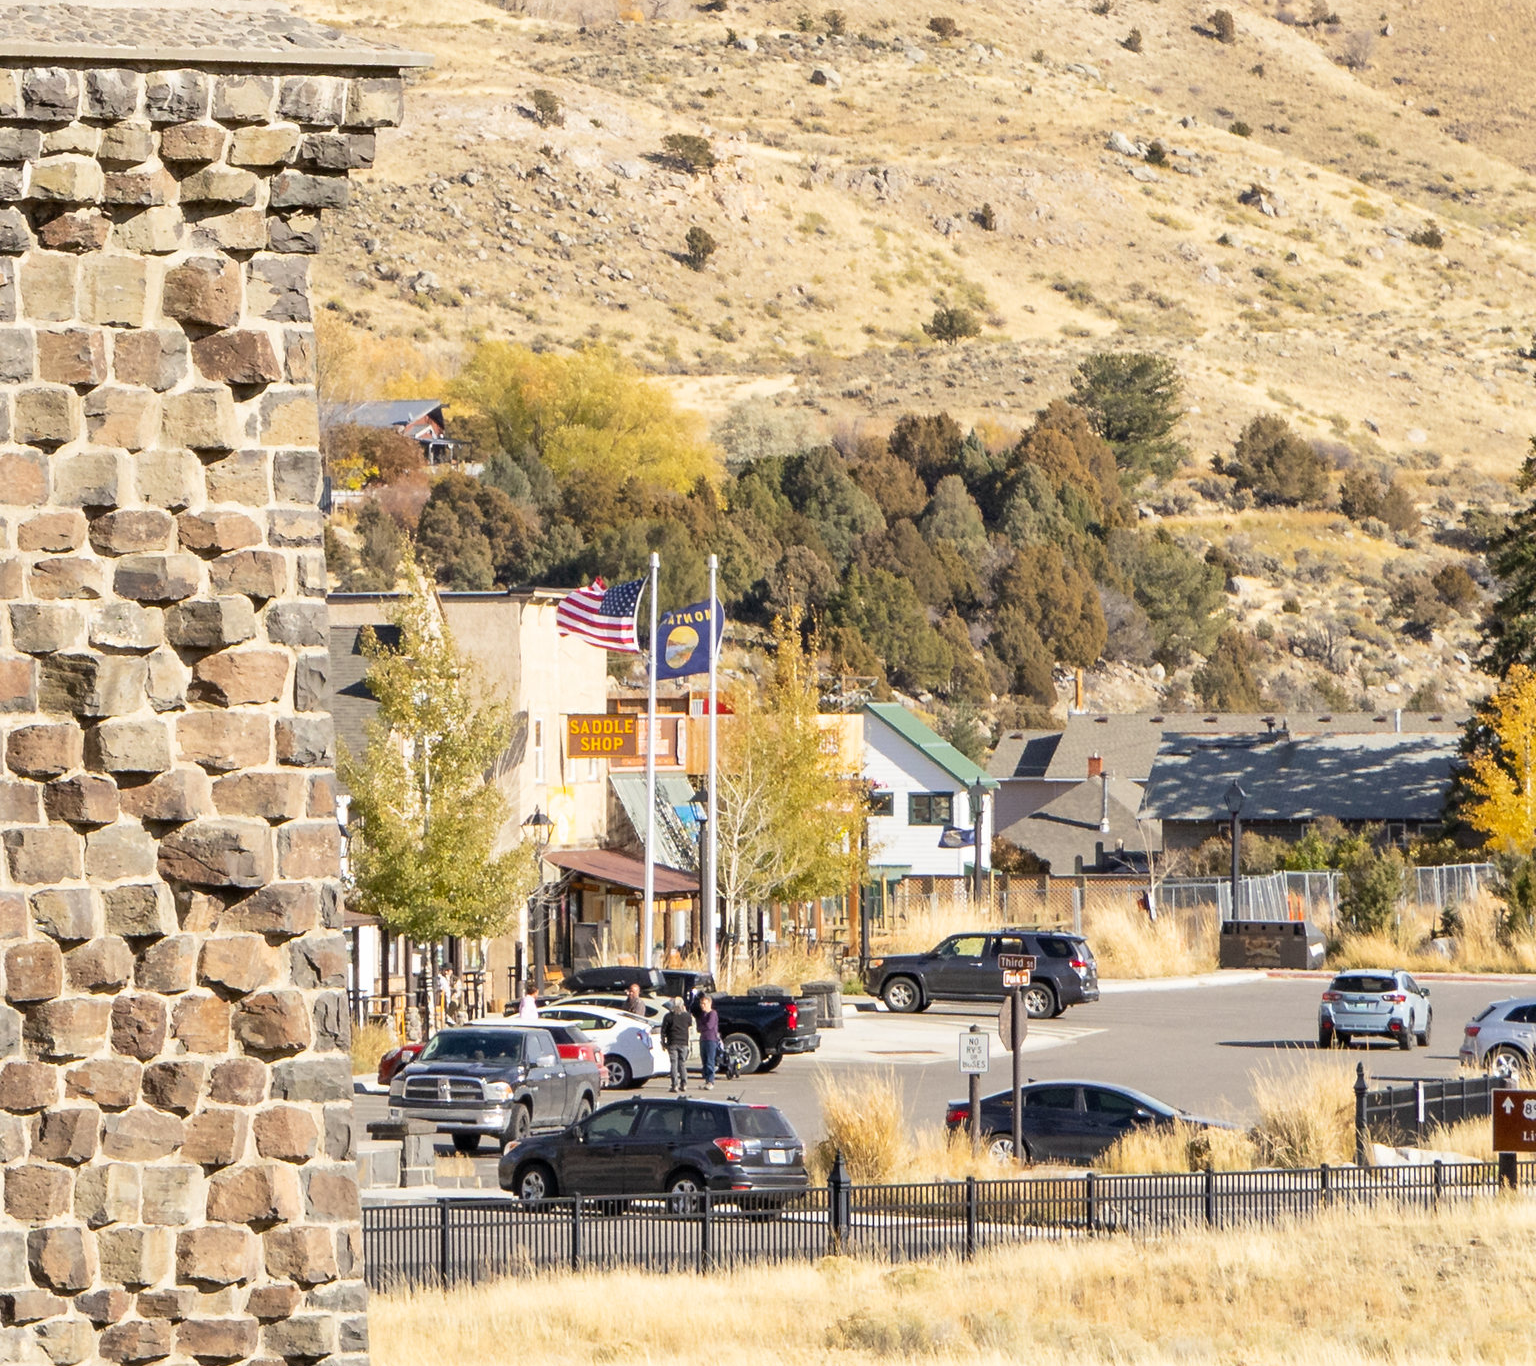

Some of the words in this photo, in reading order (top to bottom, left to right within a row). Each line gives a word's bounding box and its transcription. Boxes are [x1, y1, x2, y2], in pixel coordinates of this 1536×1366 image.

[570, 719, 633, 734] SADDLE
[580, 737, 624, 751] SHOP
[1001, 957, 1024, 967] Third
[962, 1061, 986, 1069] BUSES
